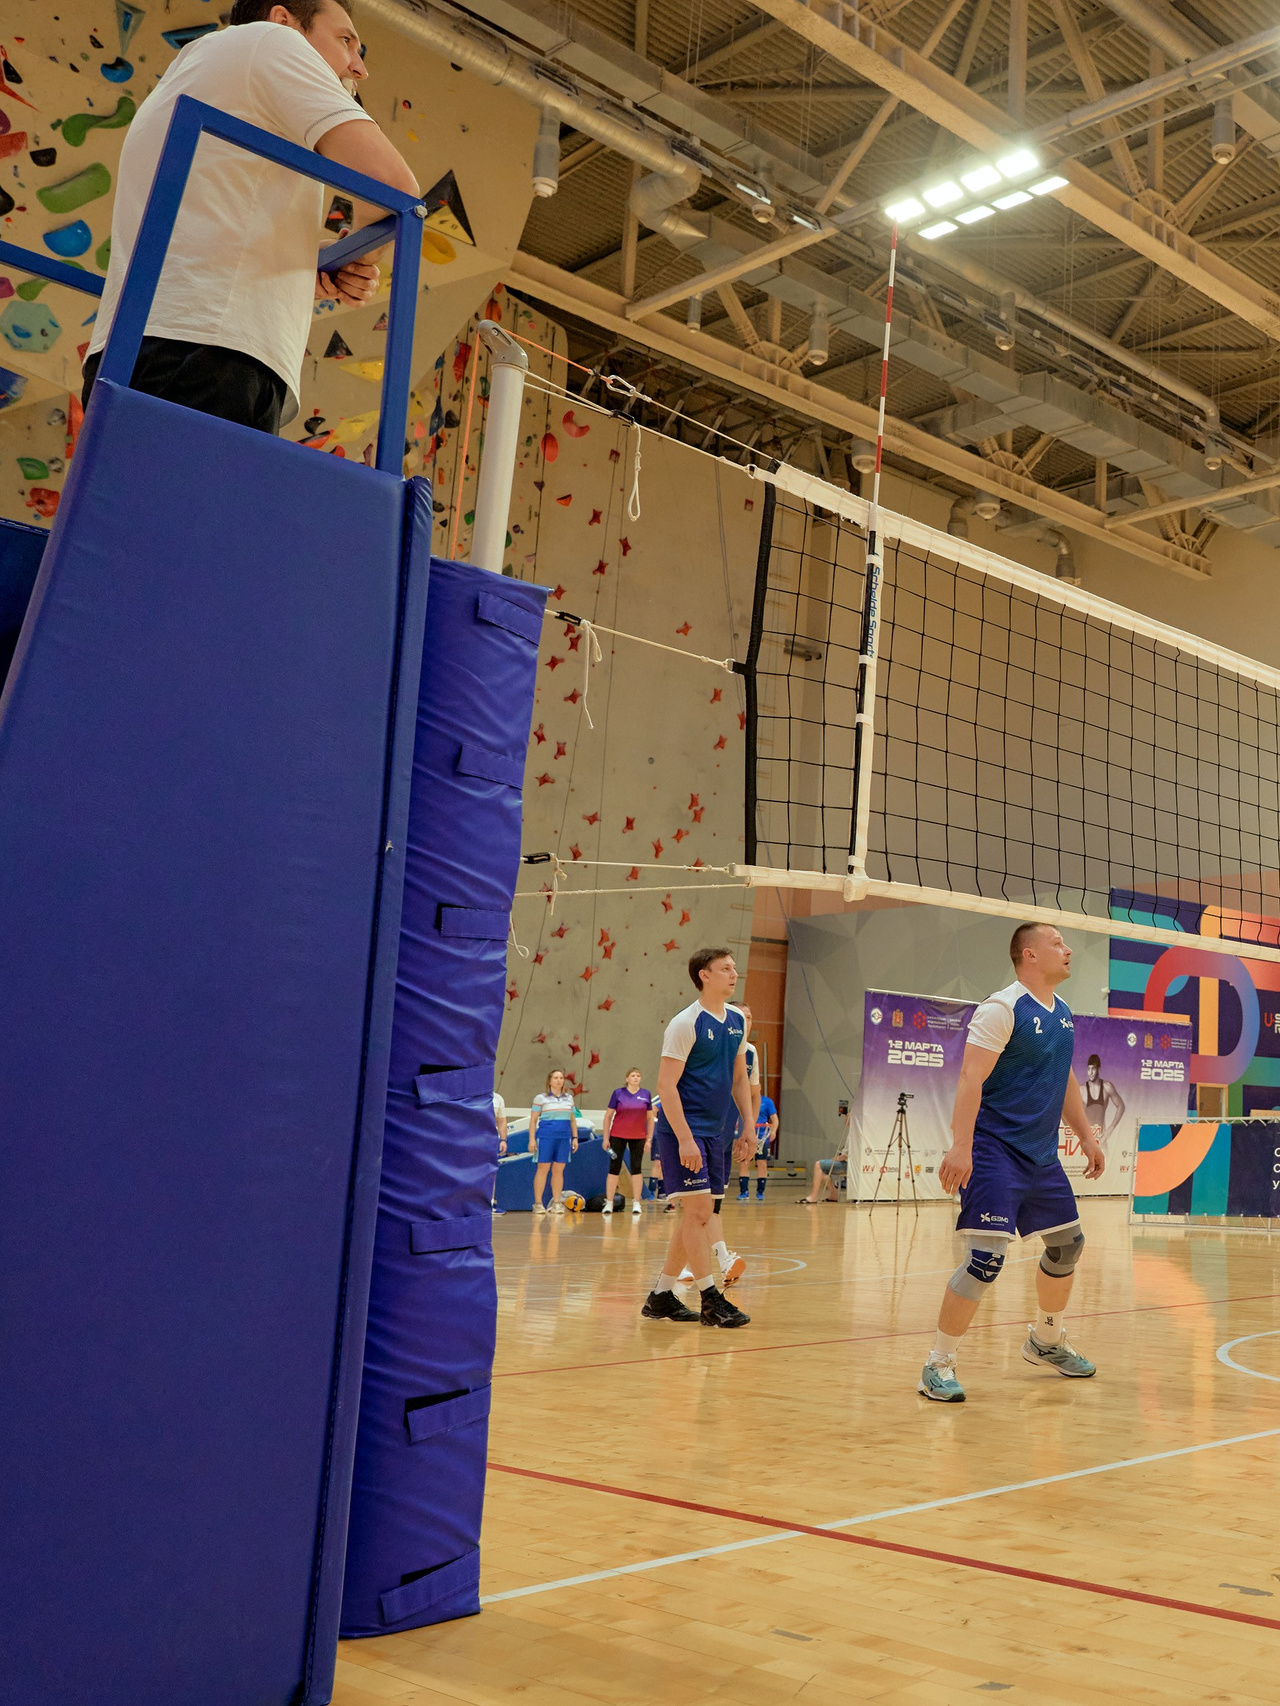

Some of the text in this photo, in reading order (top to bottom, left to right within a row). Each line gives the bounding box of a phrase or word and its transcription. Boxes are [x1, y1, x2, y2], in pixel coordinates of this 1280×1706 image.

[1033, 1016, 1043, 1034] 2
[708, 1028, 715, 1041] 4
[904, 1041, 944, 1053] МАРТА
[887, 1050, 944, 1067] 2025
[1154, 1060, 1184, 1070] МАРТА
[1140, 1068, 1184, 1082] 2025
